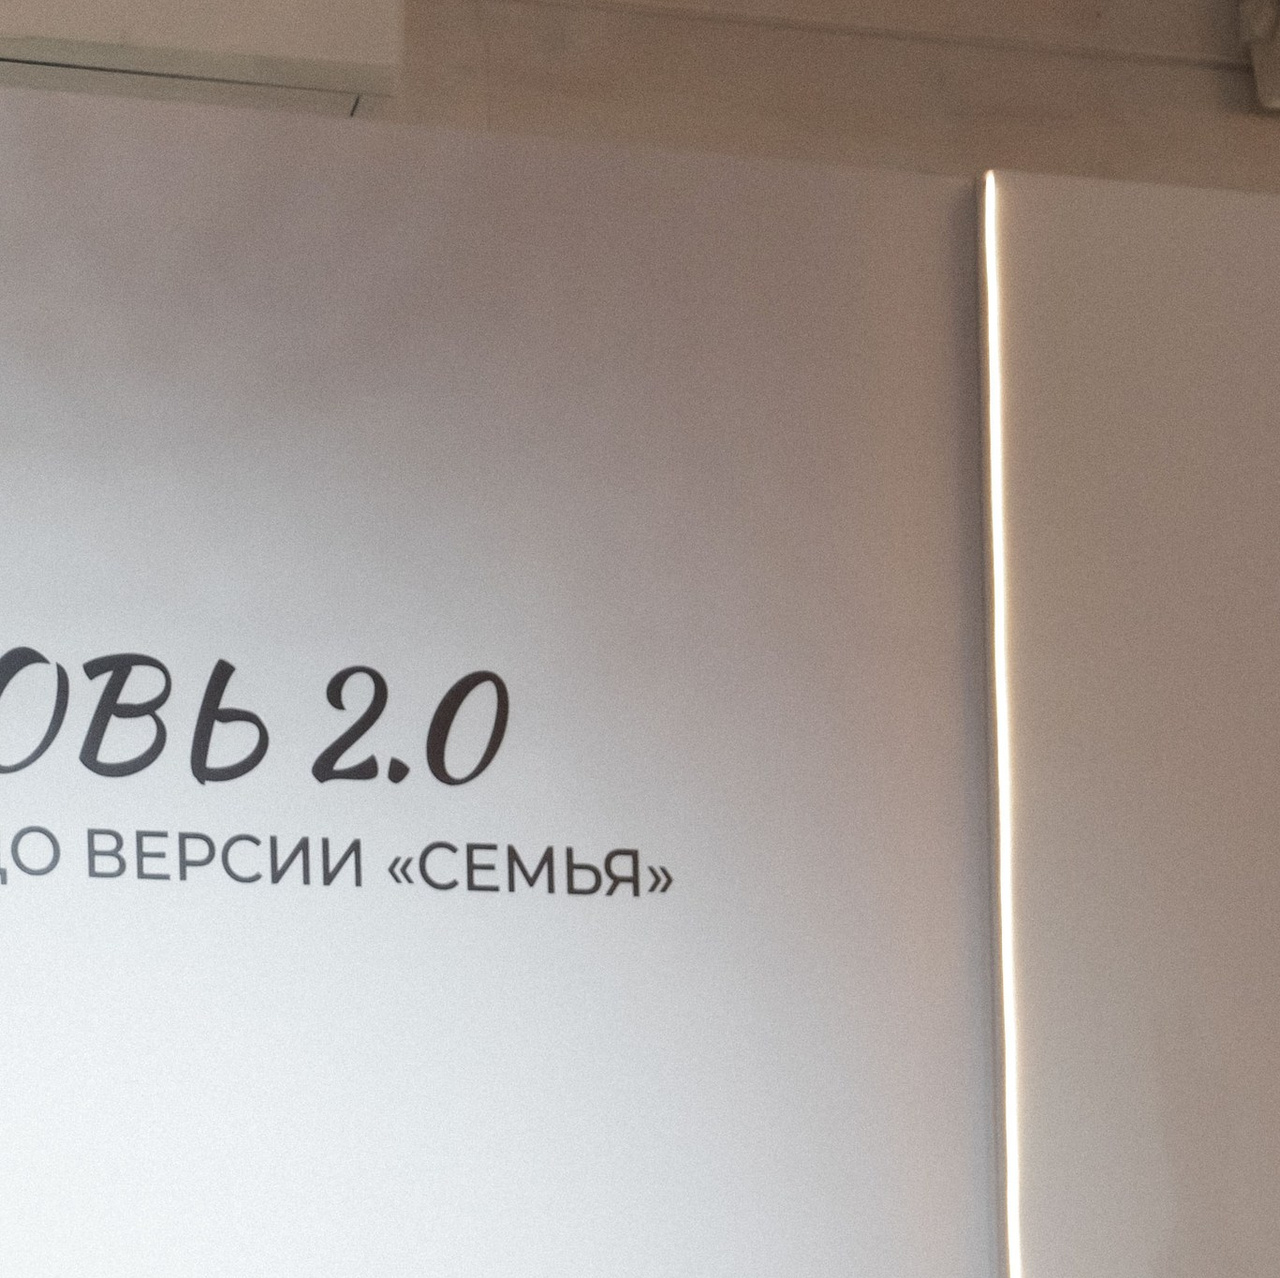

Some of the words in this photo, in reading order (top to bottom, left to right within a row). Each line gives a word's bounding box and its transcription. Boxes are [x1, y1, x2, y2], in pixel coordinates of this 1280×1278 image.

[311, 665, 510, 785] 2.0
[0, 825, 60, 885] О
[86, 828, 362, 886] ВЕРСИИ
[388, 841, 674, 897] «СЕМЬЯ»
